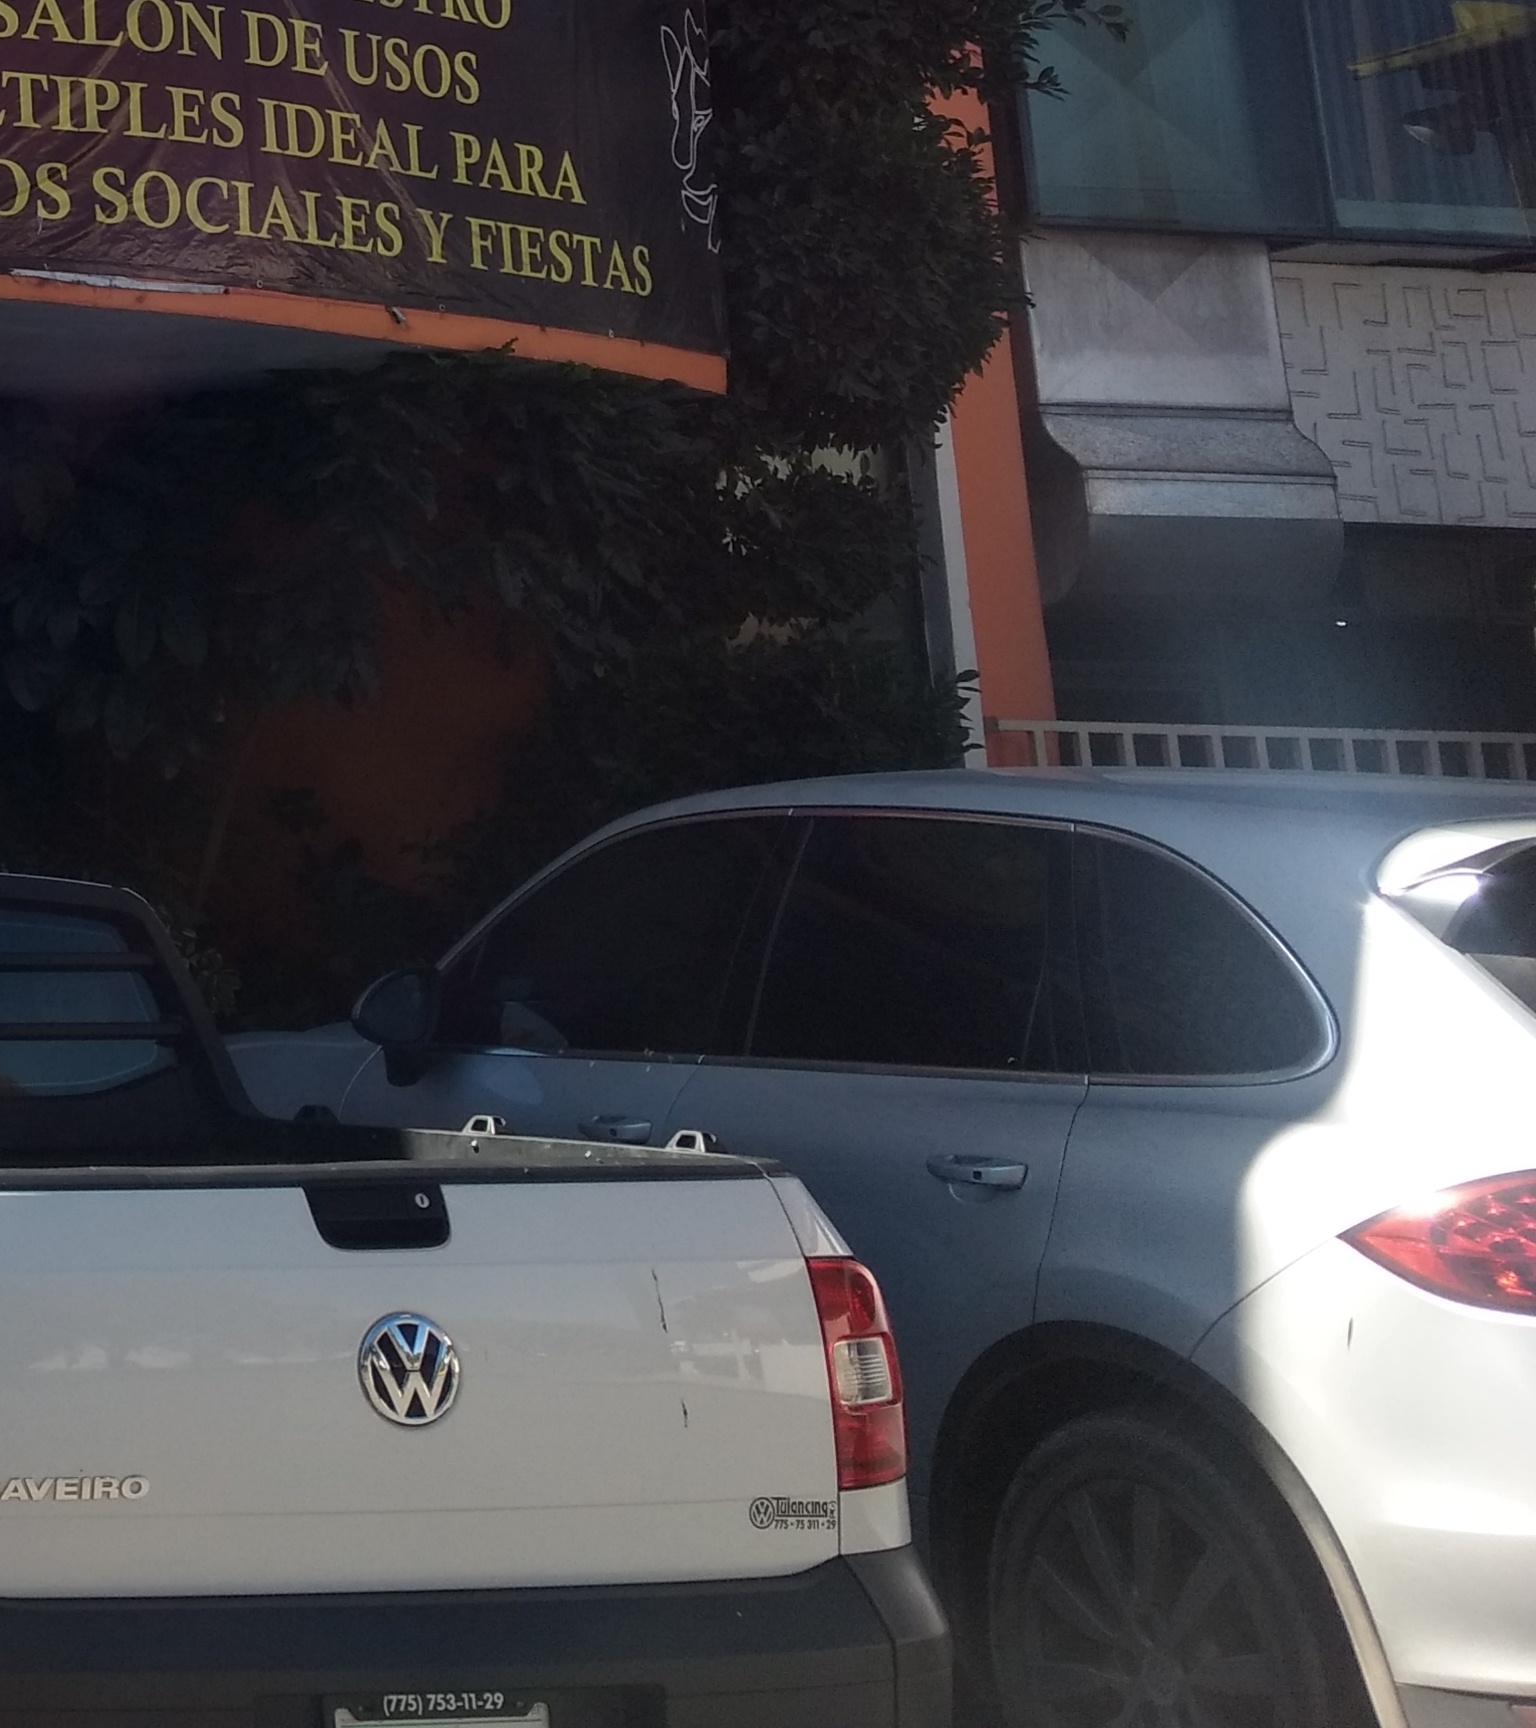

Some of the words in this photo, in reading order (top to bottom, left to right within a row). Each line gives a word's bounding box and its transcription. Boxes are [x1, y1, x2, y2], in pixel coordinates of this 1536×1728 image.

[240, 8, 330, 77] DE
[338, 27, 481, 107] USOS
[257, 97, 441, 181] IDEAL
[448, 130, 589, 206] PARA
[92, 164, 405, 259] SOCIALES
[419, 208, 454, 265] Y
[464, 214, 654, 298] FIESTAS
[383, 1694, 424, 1717] (775)
[427, 1692, 505, 1711] 753-11-29
